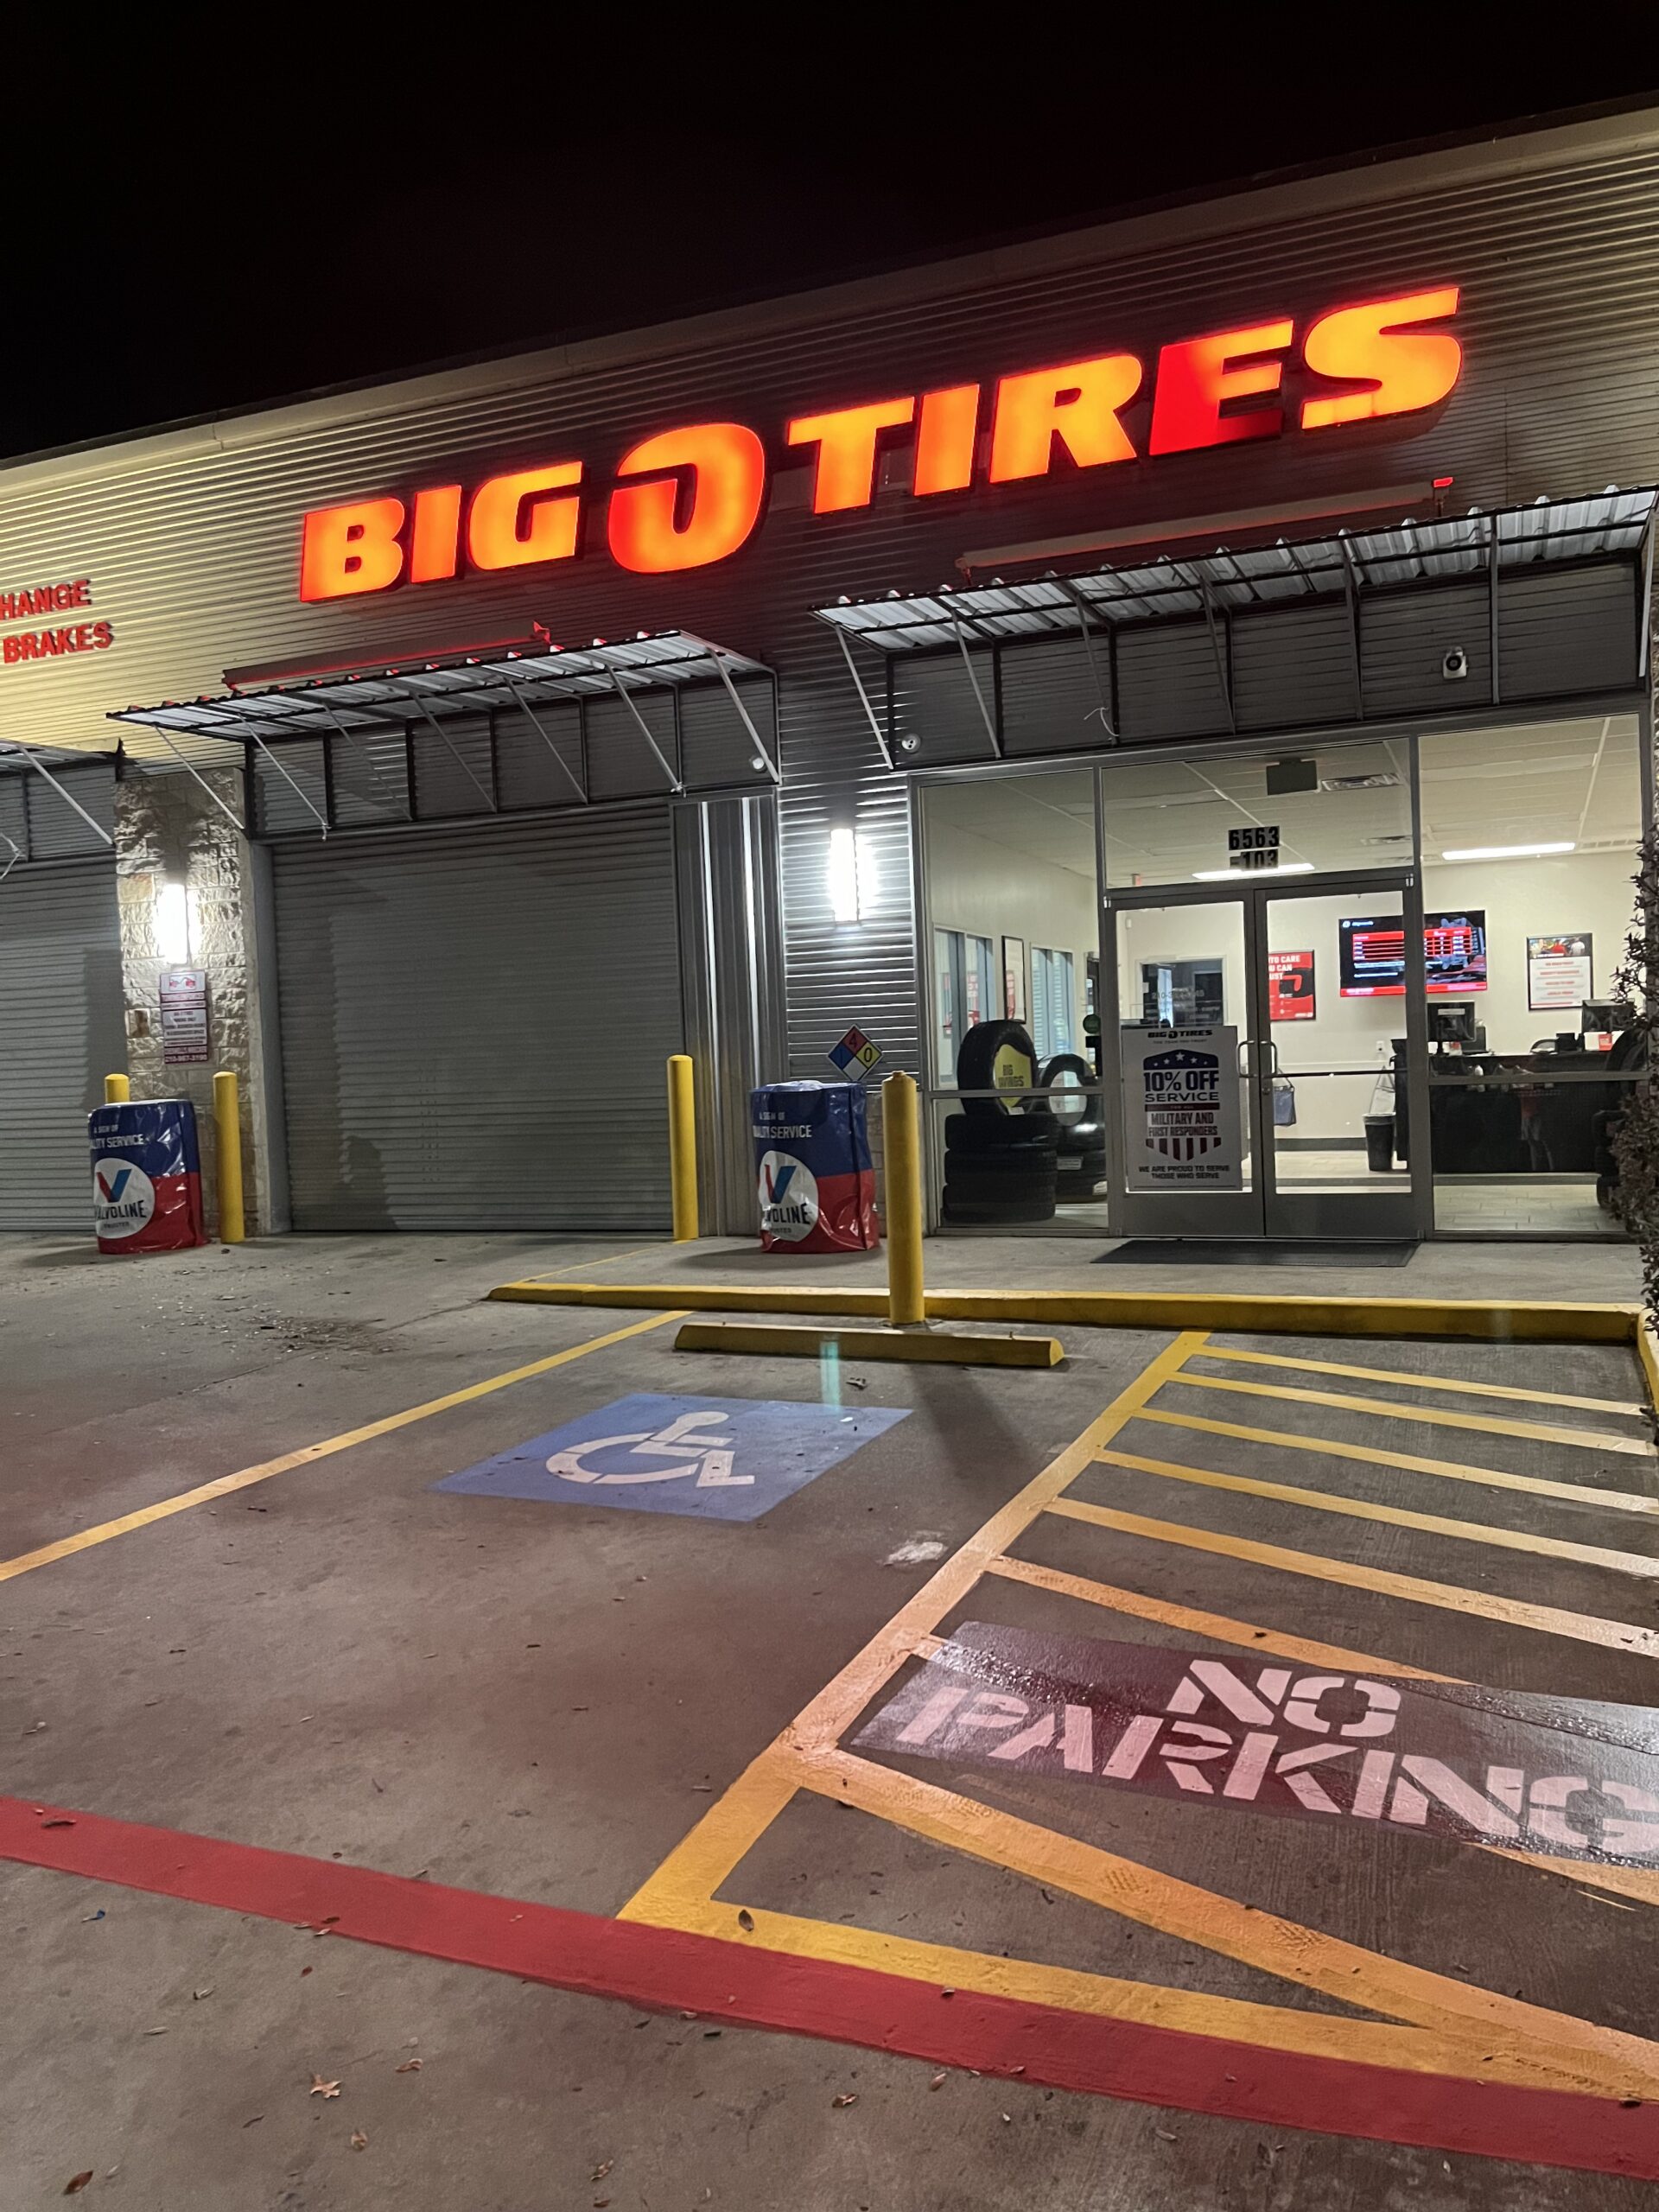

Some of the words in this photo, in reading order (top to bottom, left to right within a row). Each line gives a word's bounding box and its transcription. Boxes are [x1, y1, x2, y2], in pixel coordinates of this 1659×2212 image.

[299, 460, 584, 603] BIG
[607, 421, 766, 575] O
[787, 286, 1464, 516] TIRES
[3, 621, 114, 664] BRAKES
[1229, 826, 1280, 850] 6563
[1268, 972, 1285, 981] UST
[849, 1033, 857, 1047] 4
[864, 1047, 873, 1062] 0
[1143, 1071, 1181, 1092] 10%
[1185, 1070, 1219, 1091] OFF
[1145, 1091, 1219, 1103] SERVICE
[1151, 1112, 1193, 1125] MILITARY
[1194, 1111, 1214, 1124] AND
[771, 1125, 812, 1139] SERVICE
[1148, 1126, 1168, 1136] FIRST
[1169, 1125, 1218, 1136] RESPONDERS
[106, 1134, 145, 1148] SERVICE
[765, 1202, 810, 1224] VOLINE
[1166, 1659, 1402, 1738] NO
[897, 1687, 1659, 1854] PARKING
